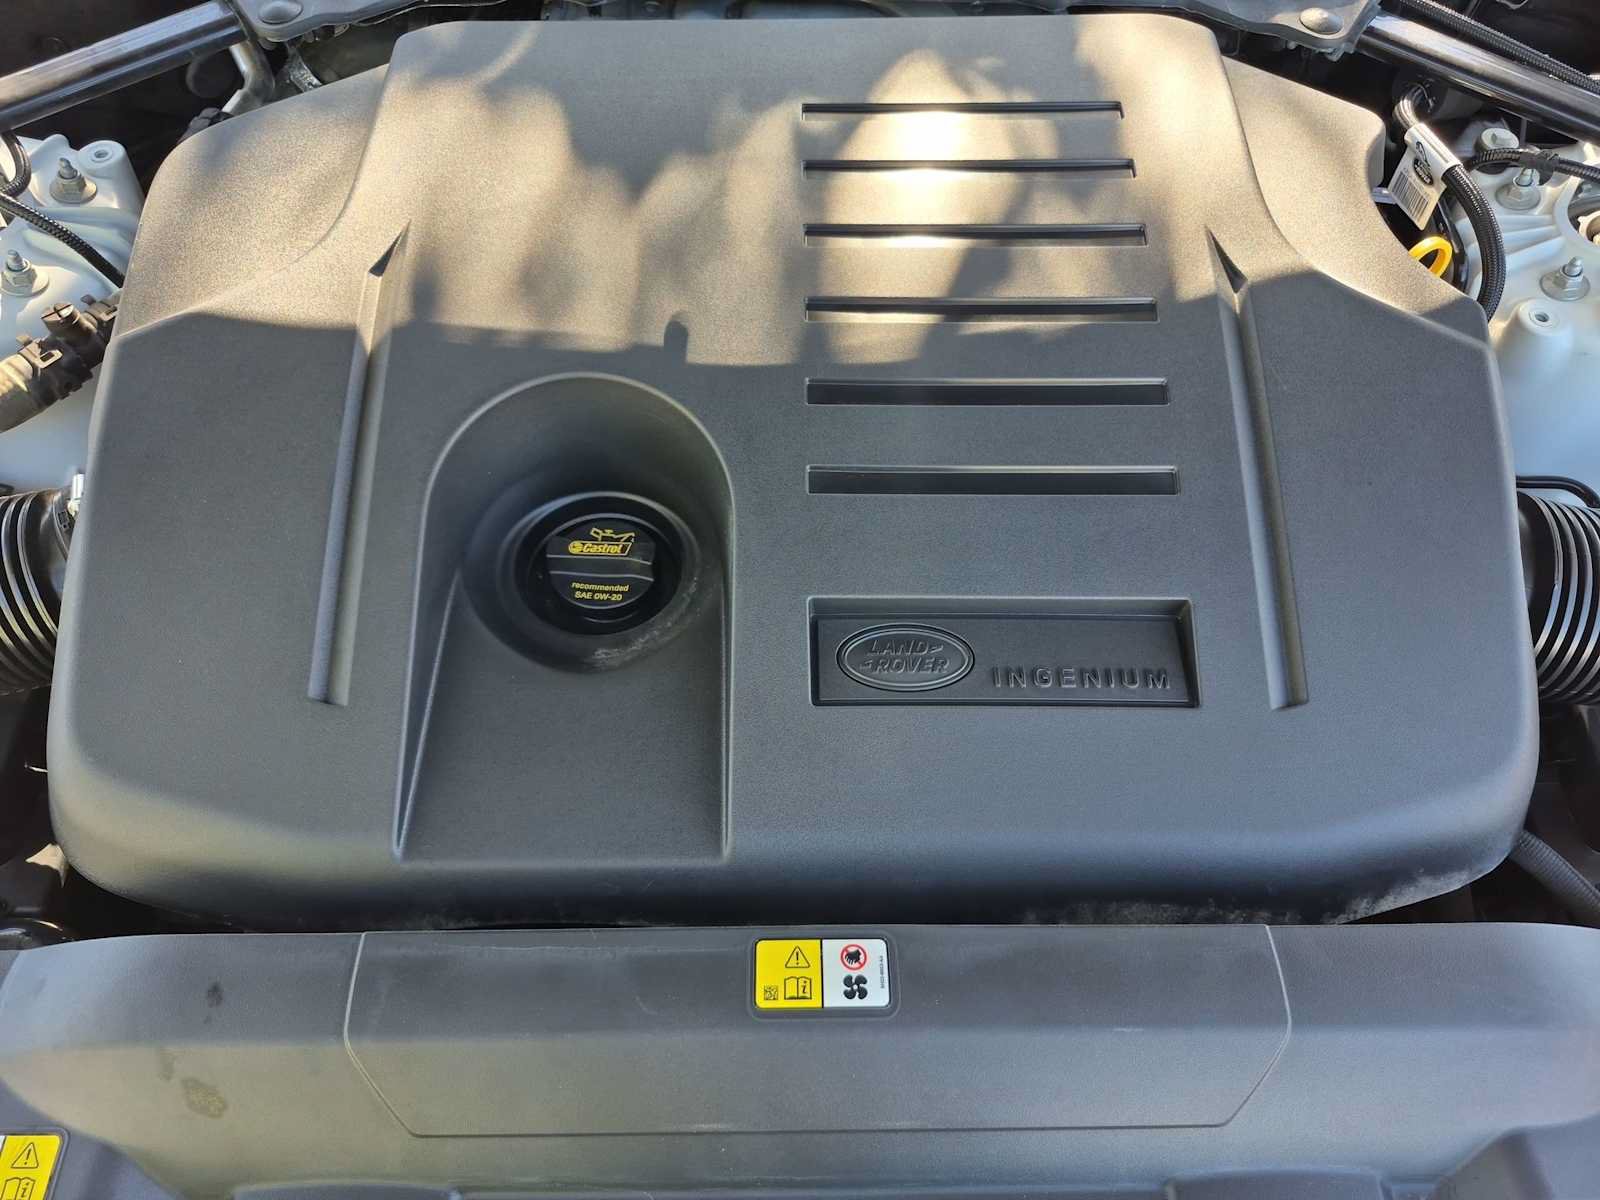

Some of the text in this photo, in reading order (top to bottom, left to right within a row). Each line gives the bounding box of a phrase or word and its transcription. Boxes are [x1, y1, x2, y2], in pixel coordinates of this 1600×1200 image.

[583, 543, 623, 554] Castrol
[571, 582, 630, 592] recommended
[575, 591, 623, 601] SAE 0W-20
[868, 639, 932, 656] LAND
[873, 657, 951, 675] ROVER
[992, 665, 1171, 690] INGENIUM
